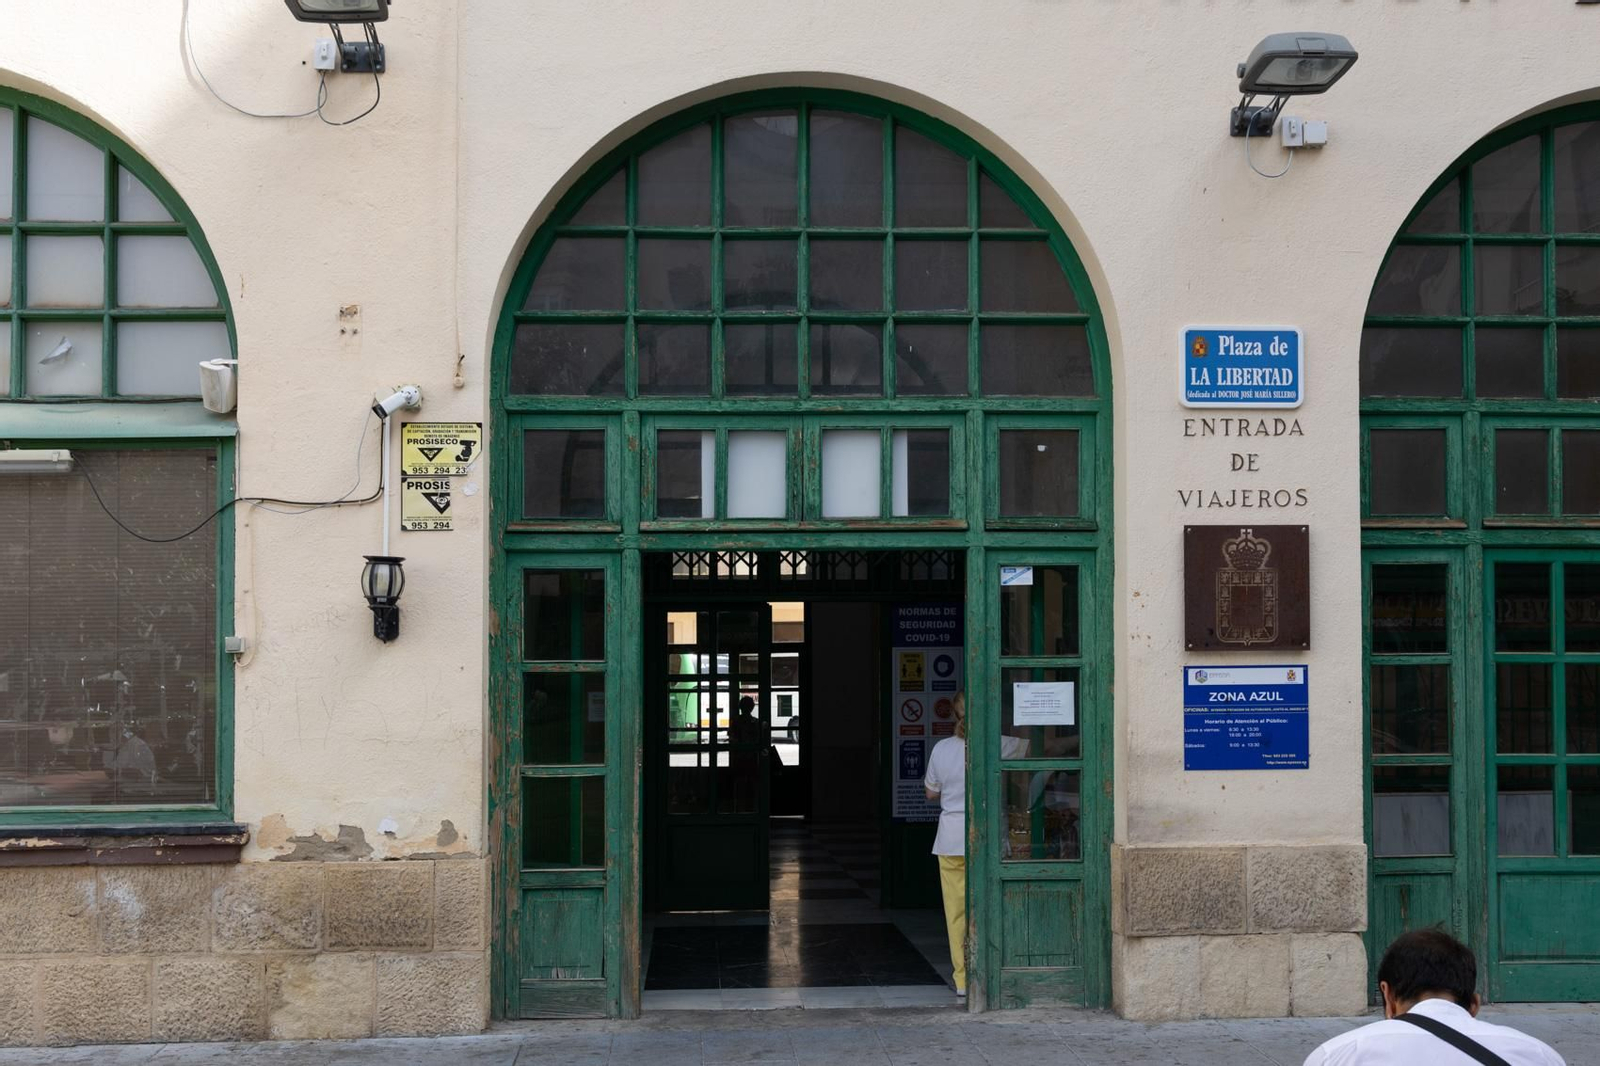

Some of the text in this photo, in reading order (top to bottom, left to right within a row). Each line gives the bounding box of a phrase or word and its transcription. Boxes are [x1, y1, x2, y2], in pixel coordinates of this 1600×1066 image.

[1218, 335, 1288, 356] Plaza de
[1190, 367, 1293, 386] LA LIBERTAD
[1187, 390, 1210, 399] (dedicada
[1212, 390, 1217, 398] al
[1240, 389, 1253, 399] JOSÉ
[1254, 389, 1272, 398] MARÍA
[1273, 390, 1297, 399] SILLERO)
[1183, 418, 1305, 437] ENTRADA
[1231, 453, 1260, 472] DE
[1178, 488, 1308, 508] VIAJEROS
[899, 608, 957, 616] NORMAS DE
[900, 620, 956, 629] SEGURIDAD
[905, 634, 950, 642] COVID-19
[1208, 691, 1284, 702] ZONA AZUL
